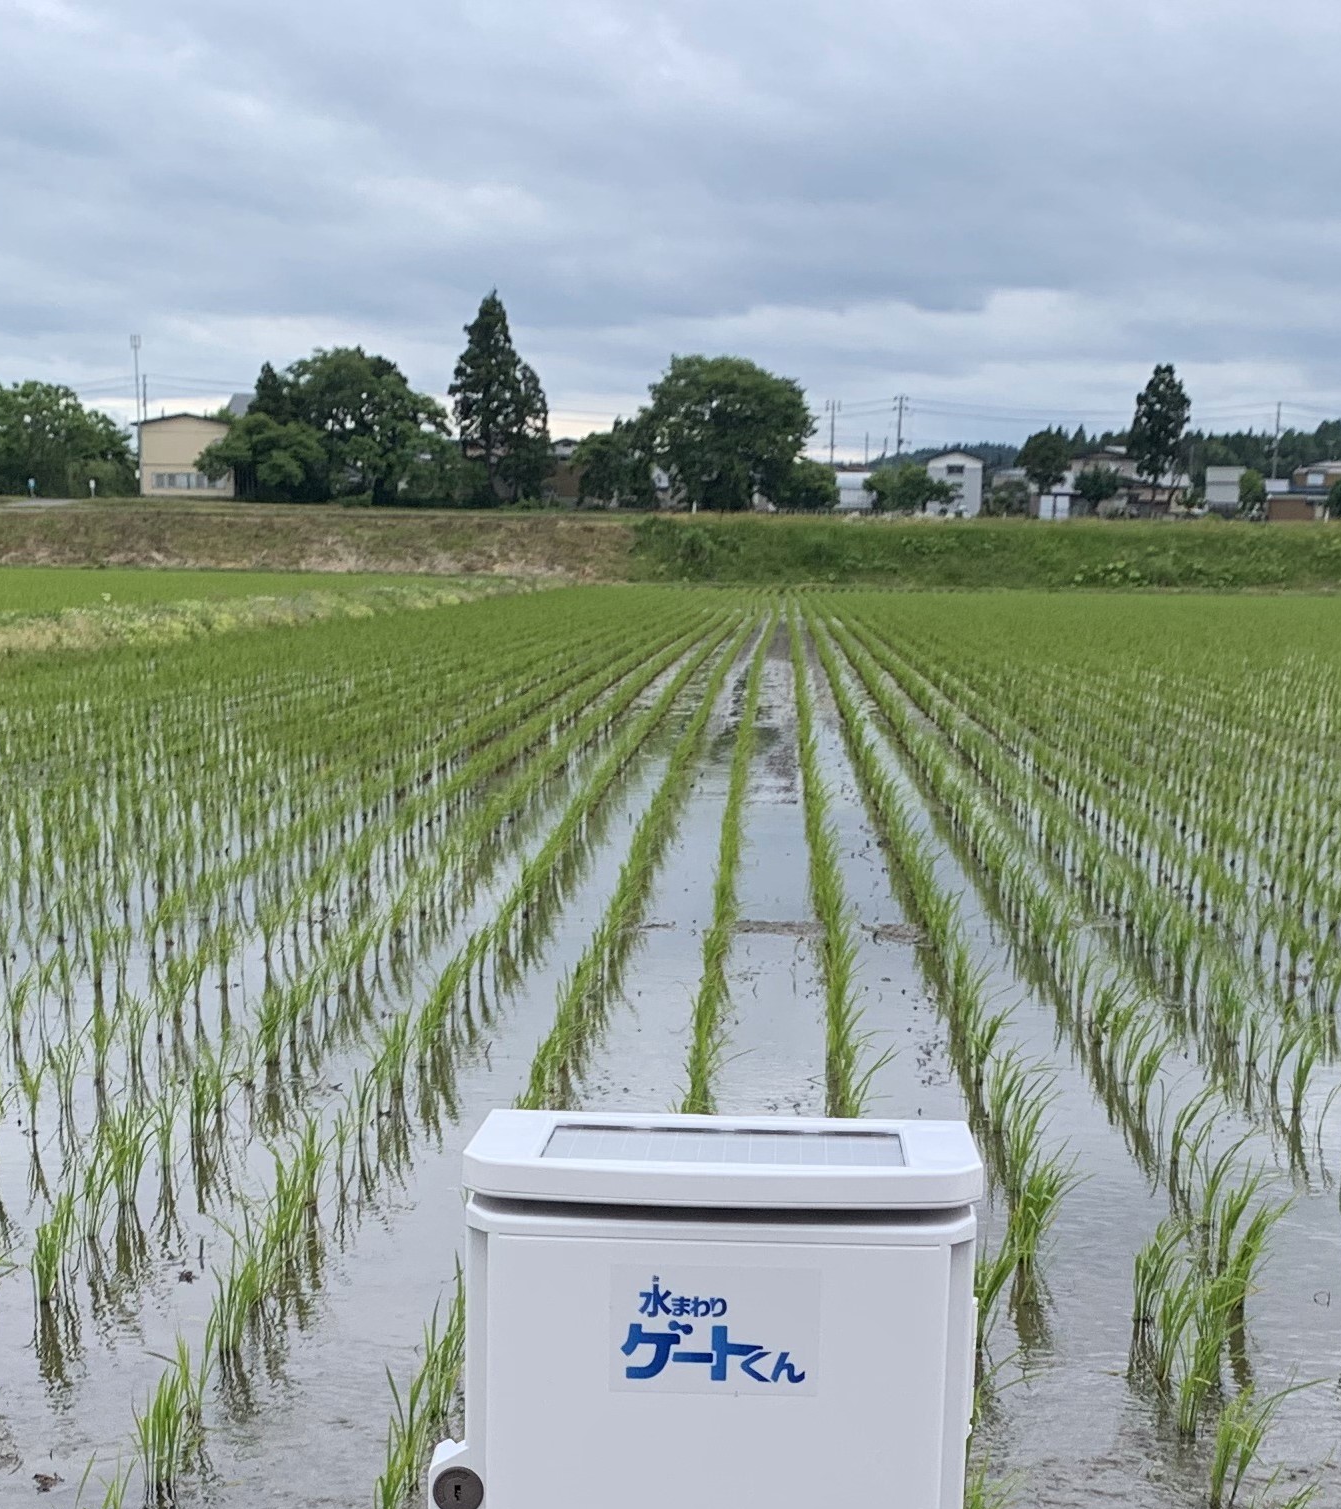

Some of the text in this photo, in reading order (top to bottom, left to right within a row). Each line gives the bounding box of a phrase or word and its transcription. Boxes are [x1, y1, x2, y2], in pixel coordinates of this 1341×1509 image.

[639, 1283, 727, 1317] 水まわり
[620, 1320, 805, 1384] ゲートくん
